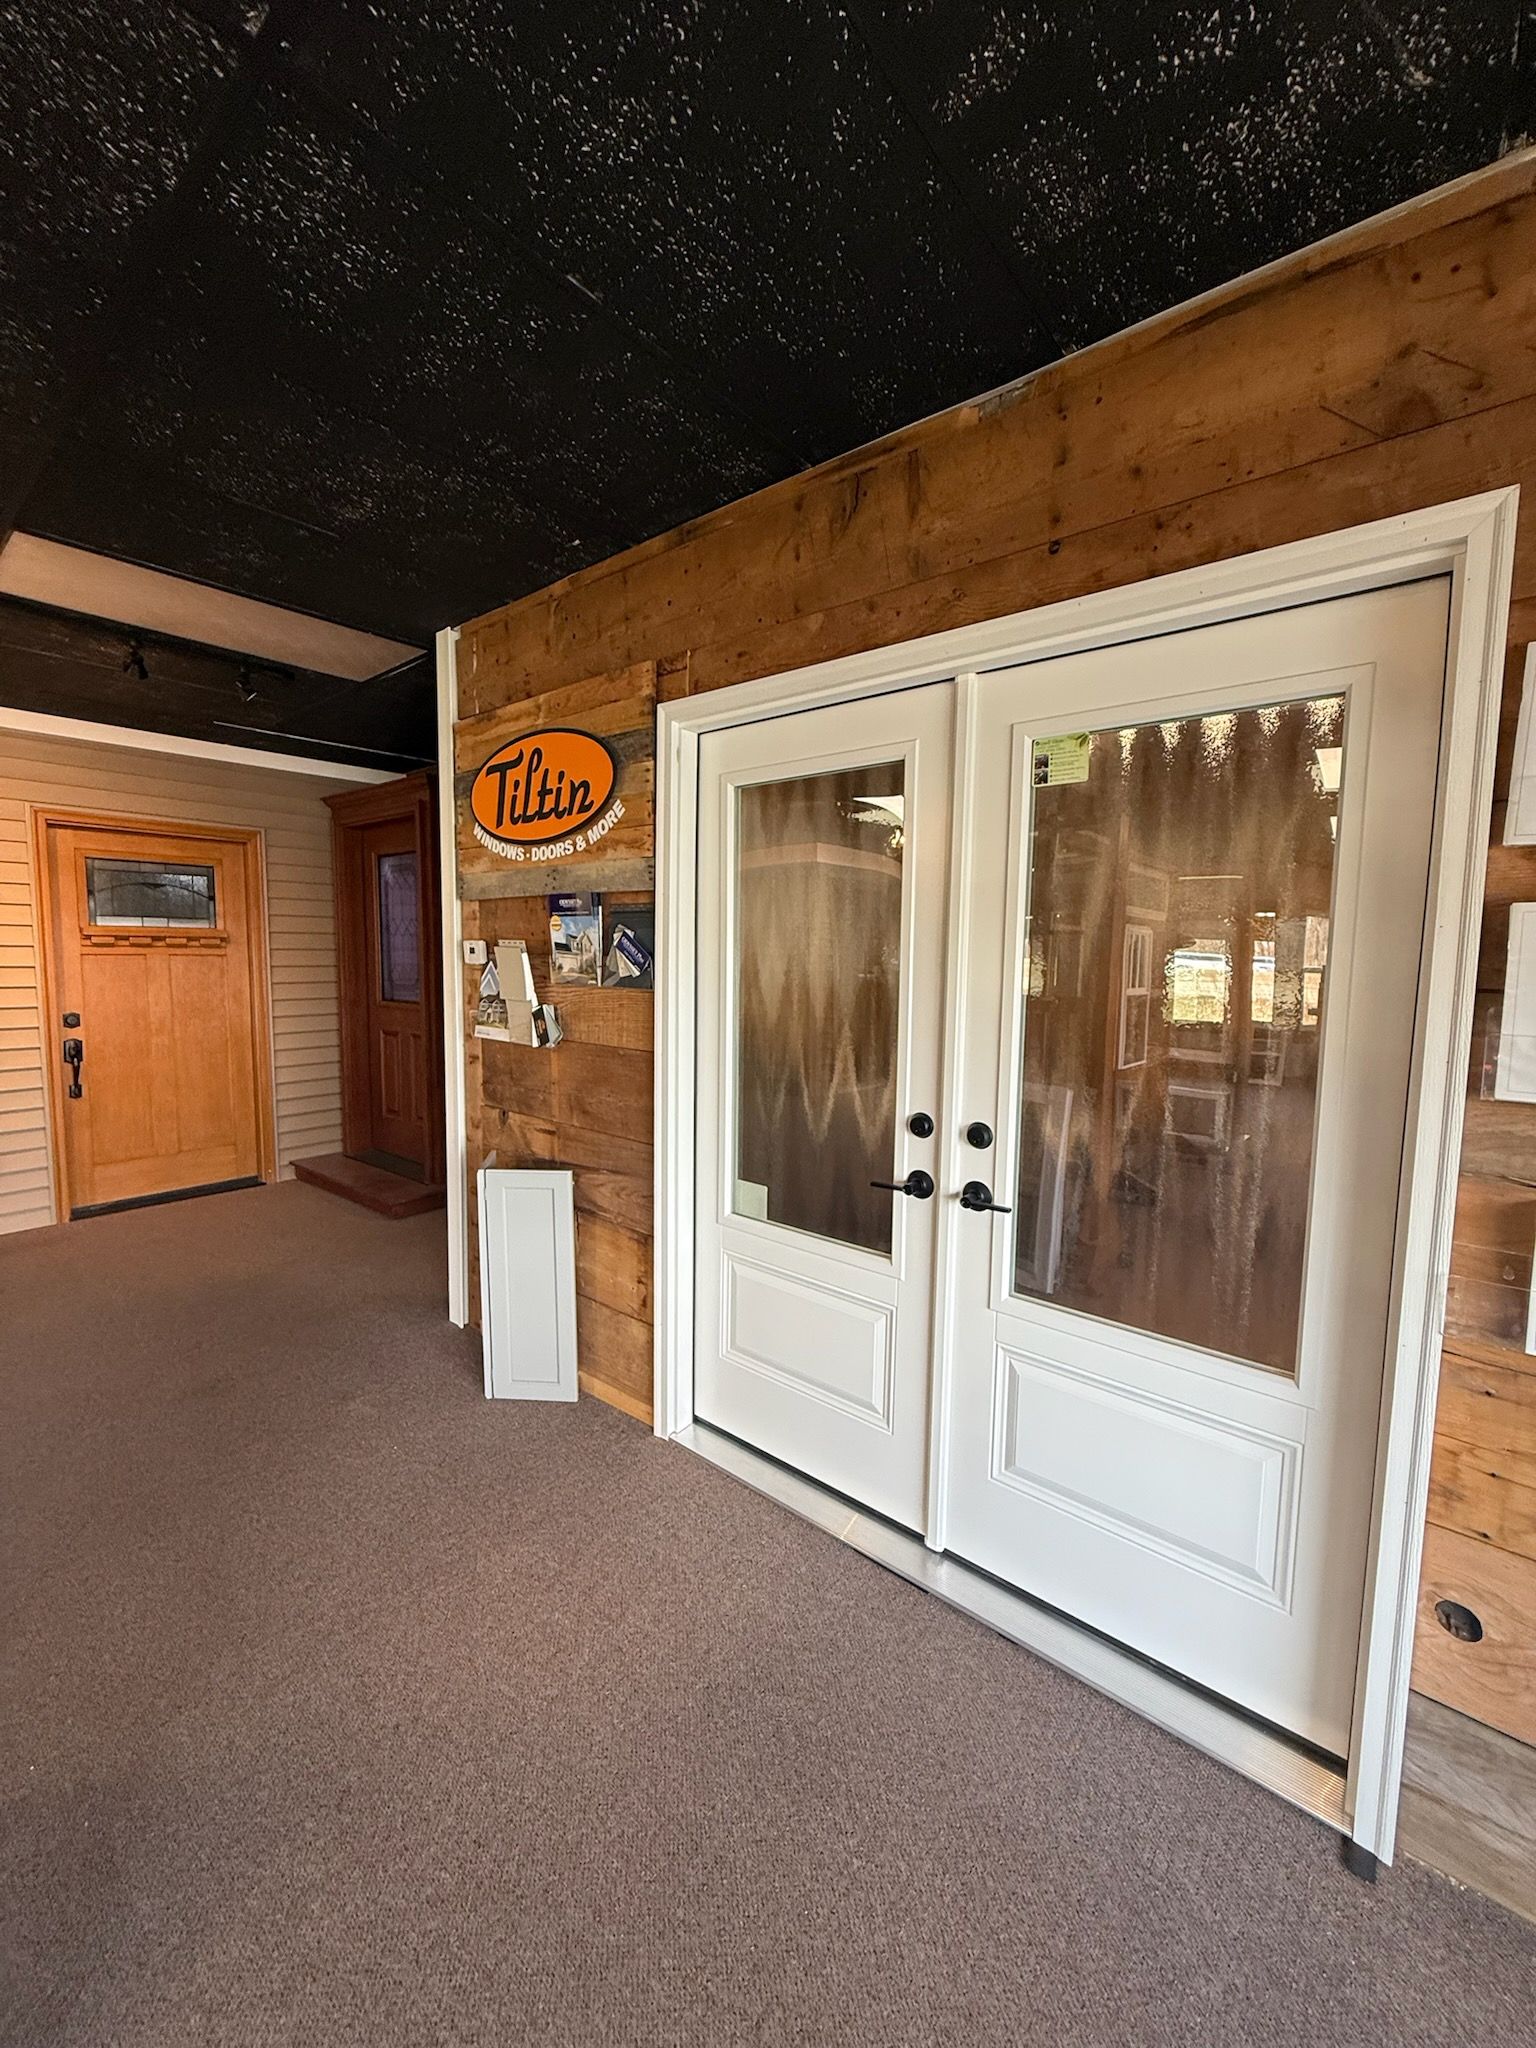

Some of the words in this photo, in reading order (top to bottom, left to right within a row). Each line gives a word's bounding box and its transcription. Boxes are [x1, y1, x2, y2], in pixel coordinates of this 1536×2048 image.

[485, 748, 594, 829] Tiltin
[473, 823, 525, 861] WINDOWS
[531, 839, 574, 862] DOORS
[576, 835, 587, 851] &
[588, 799, 626, 845] MORE
